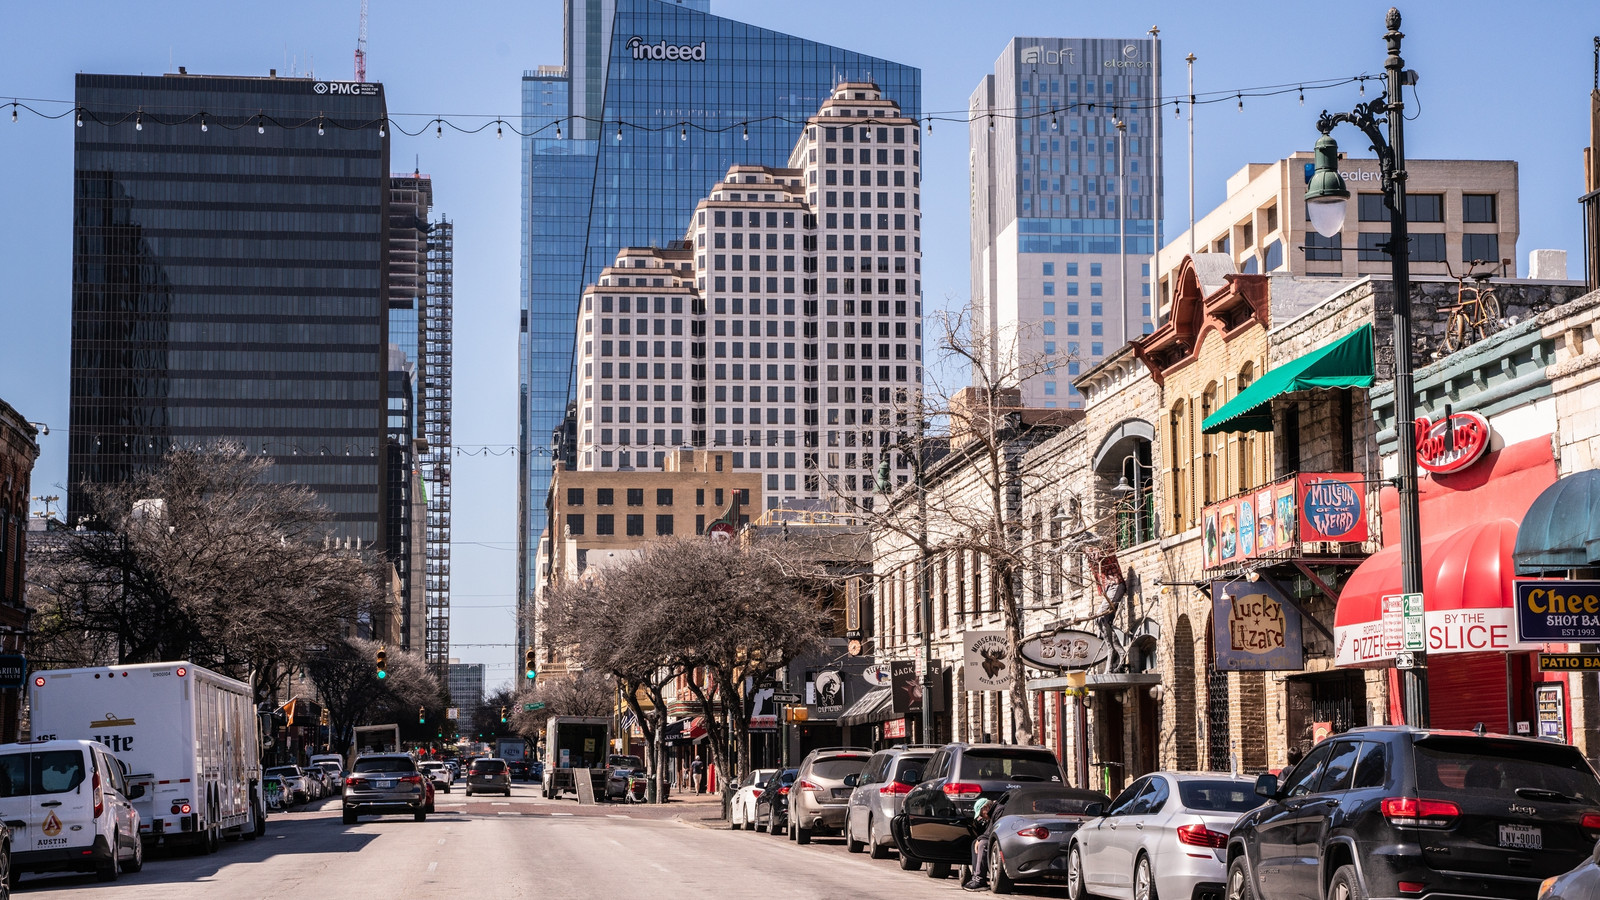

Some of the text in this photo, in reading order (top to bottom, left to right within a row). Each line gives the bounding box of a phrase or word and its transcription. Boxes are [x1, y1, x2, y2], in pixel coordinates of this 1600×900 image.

[629, 37, 705, 61] indeed
[1021, 45, 1075, 64] aloft
[1104, 59, 1154, 68] elemen
[330, 83, 360, 94] PMG
[1310, 477, 1354, 506] MUSEUM
[1313, 512, 1353, 537] WEIRD
[1231, 594, 1282, 621] Lucky
[1404, 598, 1410, 614] 2
[1444, 613, 1485, 624] BY THE
[1546, 615, 1578, 627] SHOT
[1231, 618, 1285, 651] Lizard
[1429, 625, 1509, 650] SLICE
[1040, 638, 1090, 659] 512
[1541, 658, 1578, 667] PATIO
[1518, 723, 1529, 731] ATM
[1508, 803, 1537, 815] Jeep
[37, 838, 68, 846] AUSTIN
